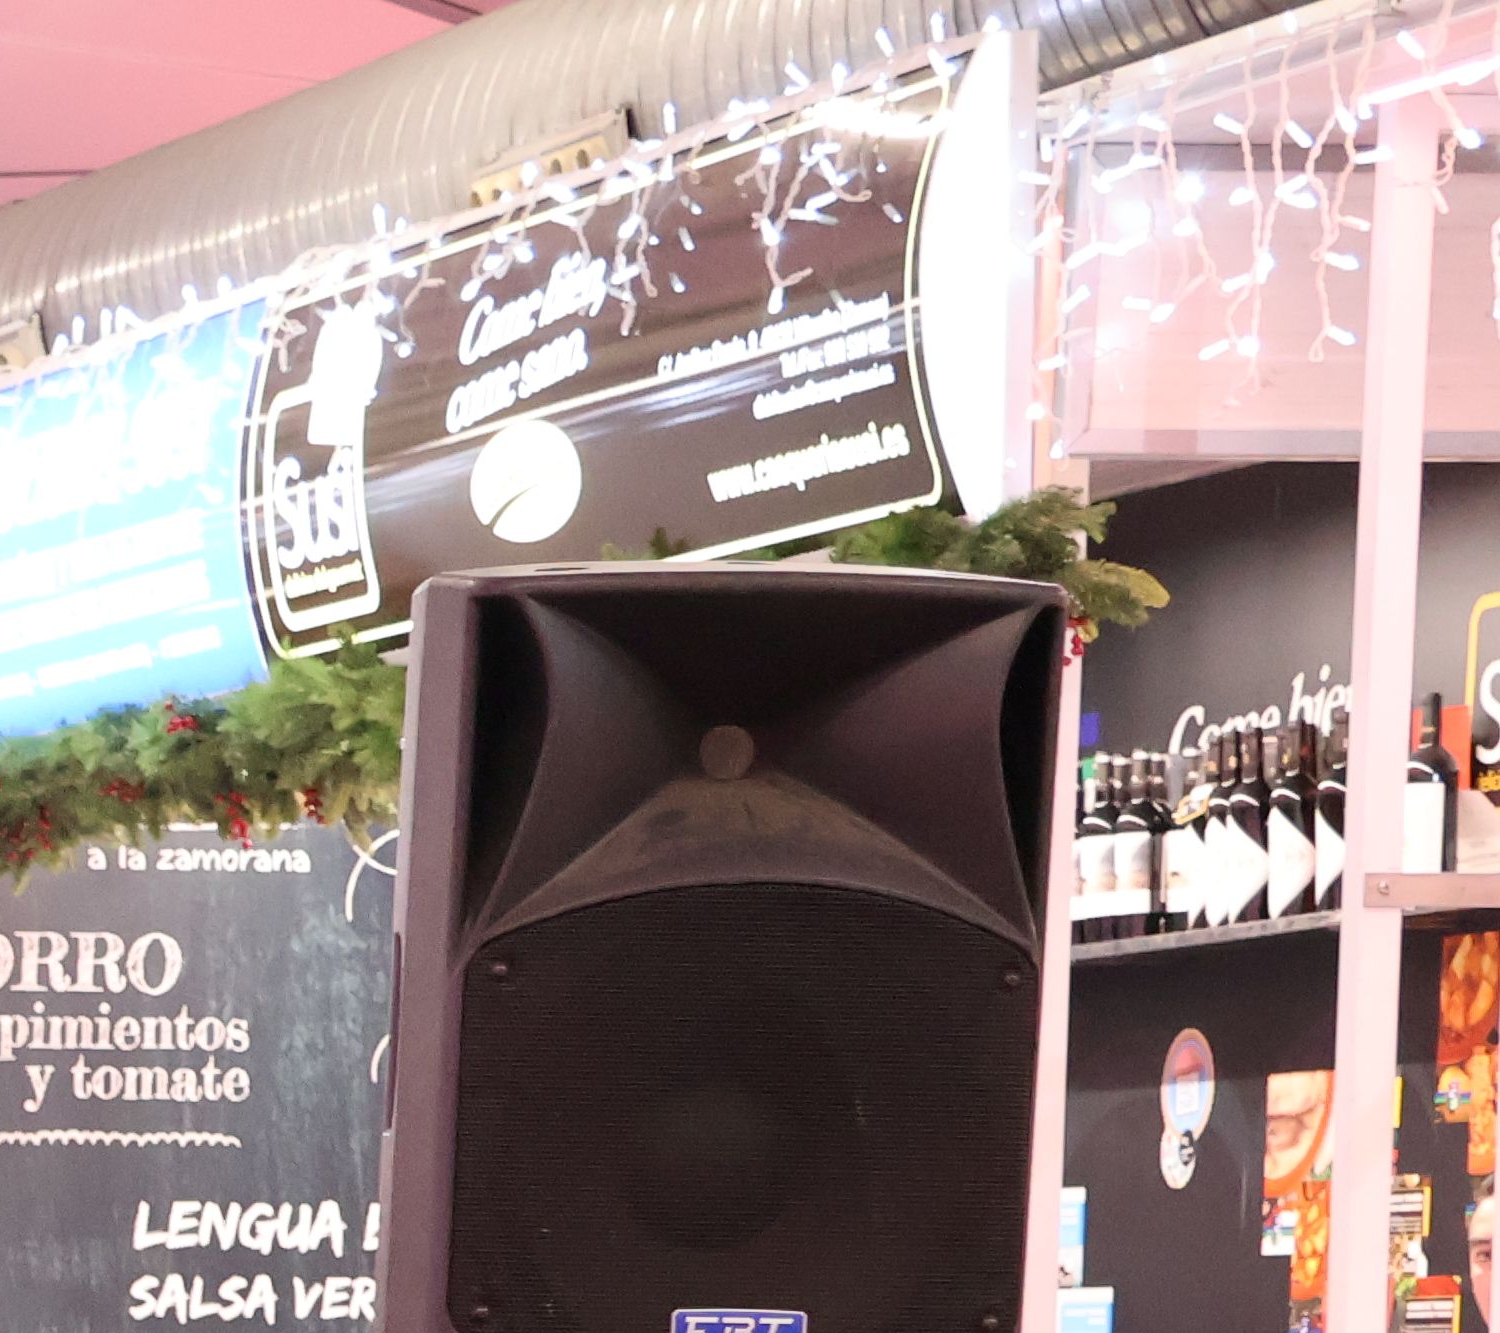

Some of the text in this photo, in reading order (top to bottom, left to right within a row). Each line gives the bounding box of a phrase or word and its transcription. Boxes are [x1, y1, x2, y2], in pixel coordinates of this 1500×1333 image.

[87, 844, 311, 873] a la zamorana
[24, 1054, 251, 1112] y tomate
[132, 1200, 348, 1257] LENGUA
[128, 1273, 279, 1324] SALSA
